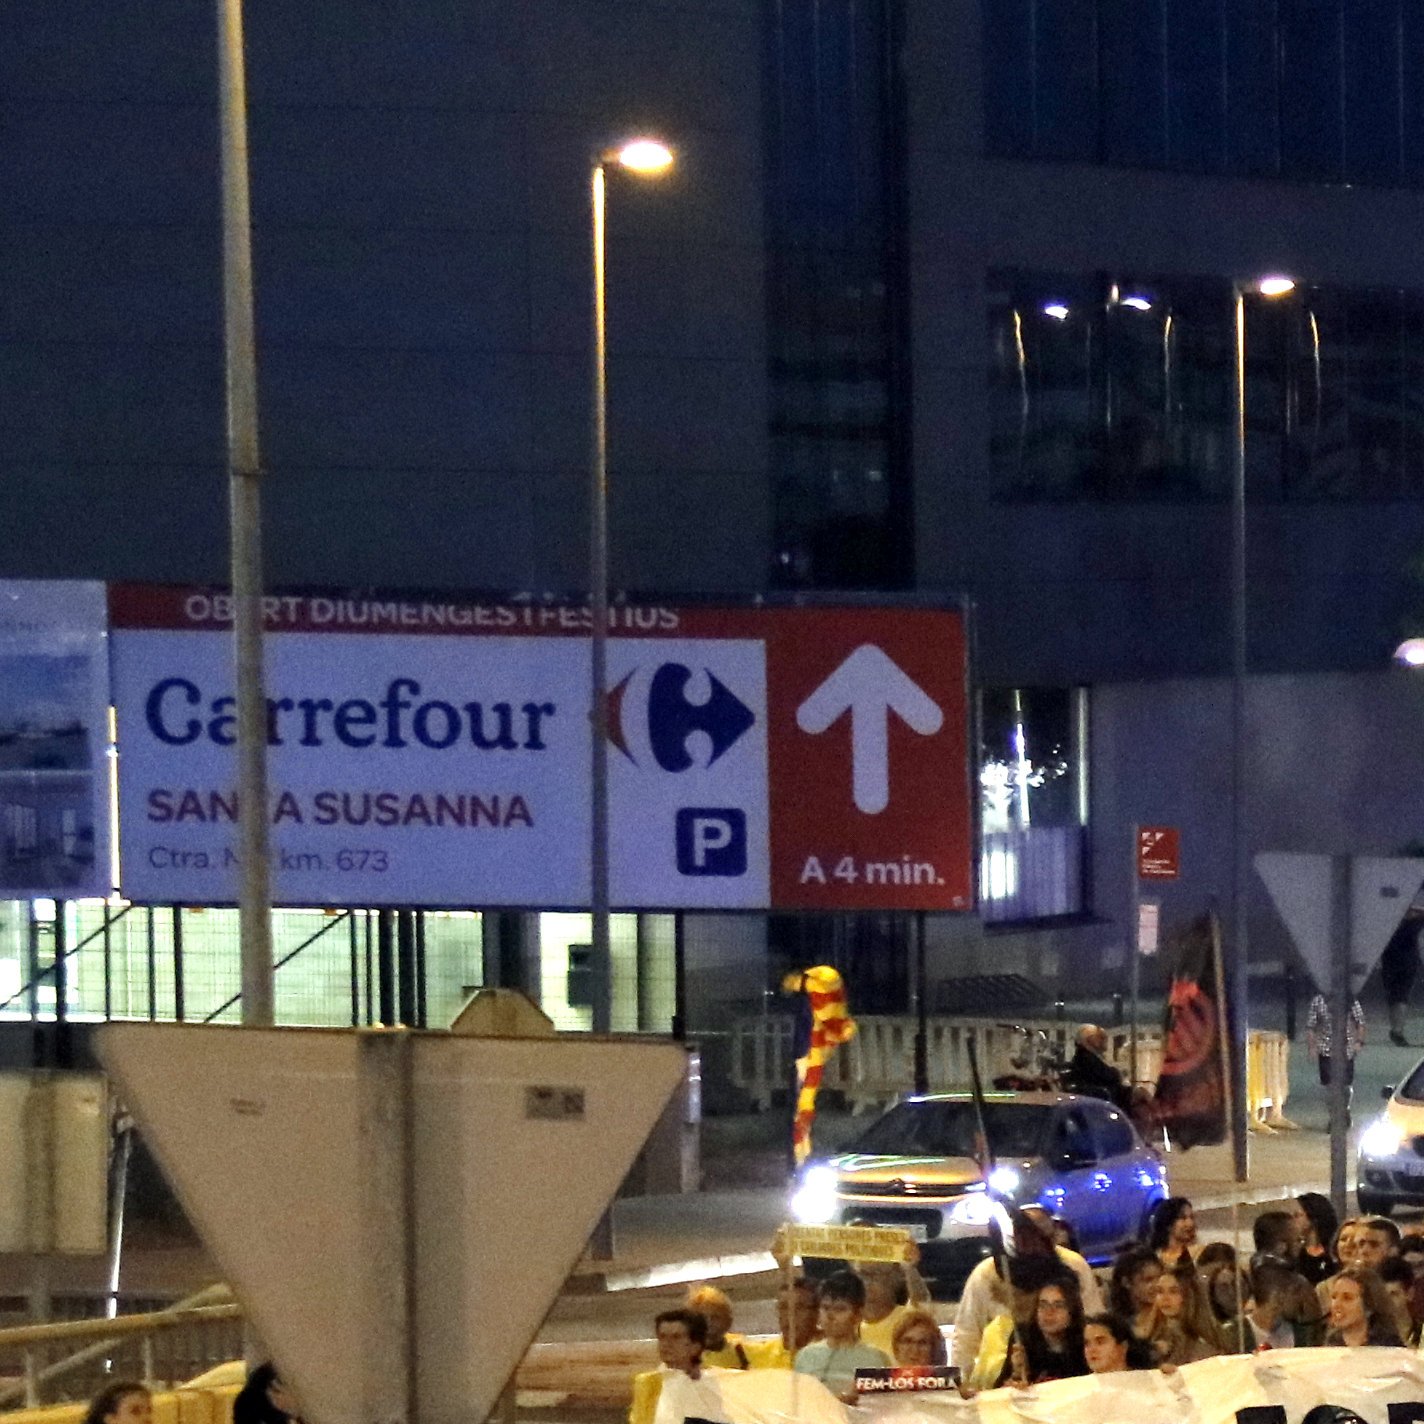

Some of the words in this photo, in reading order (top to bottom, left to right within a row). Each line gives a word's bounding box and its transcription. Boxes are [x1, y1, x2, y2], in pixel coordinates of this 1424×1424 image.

[185, 594, 304, 622] OBRT
[145, 677, 556, 750] Carrefour
[147, 789, 302, 824] SANA
[313, 791, 534, 828] SUSANNA
[693, 817, 732, 867] P
[336, 849, 389, 872] 673
[801, 856, 826, 884] A
[833, 856, 858, 884] 4
[865, 855, 945, 885] min.
[856, 1376, 915, 1390] FEM-LOS
[917, 1376, 957, 1389] FORA
